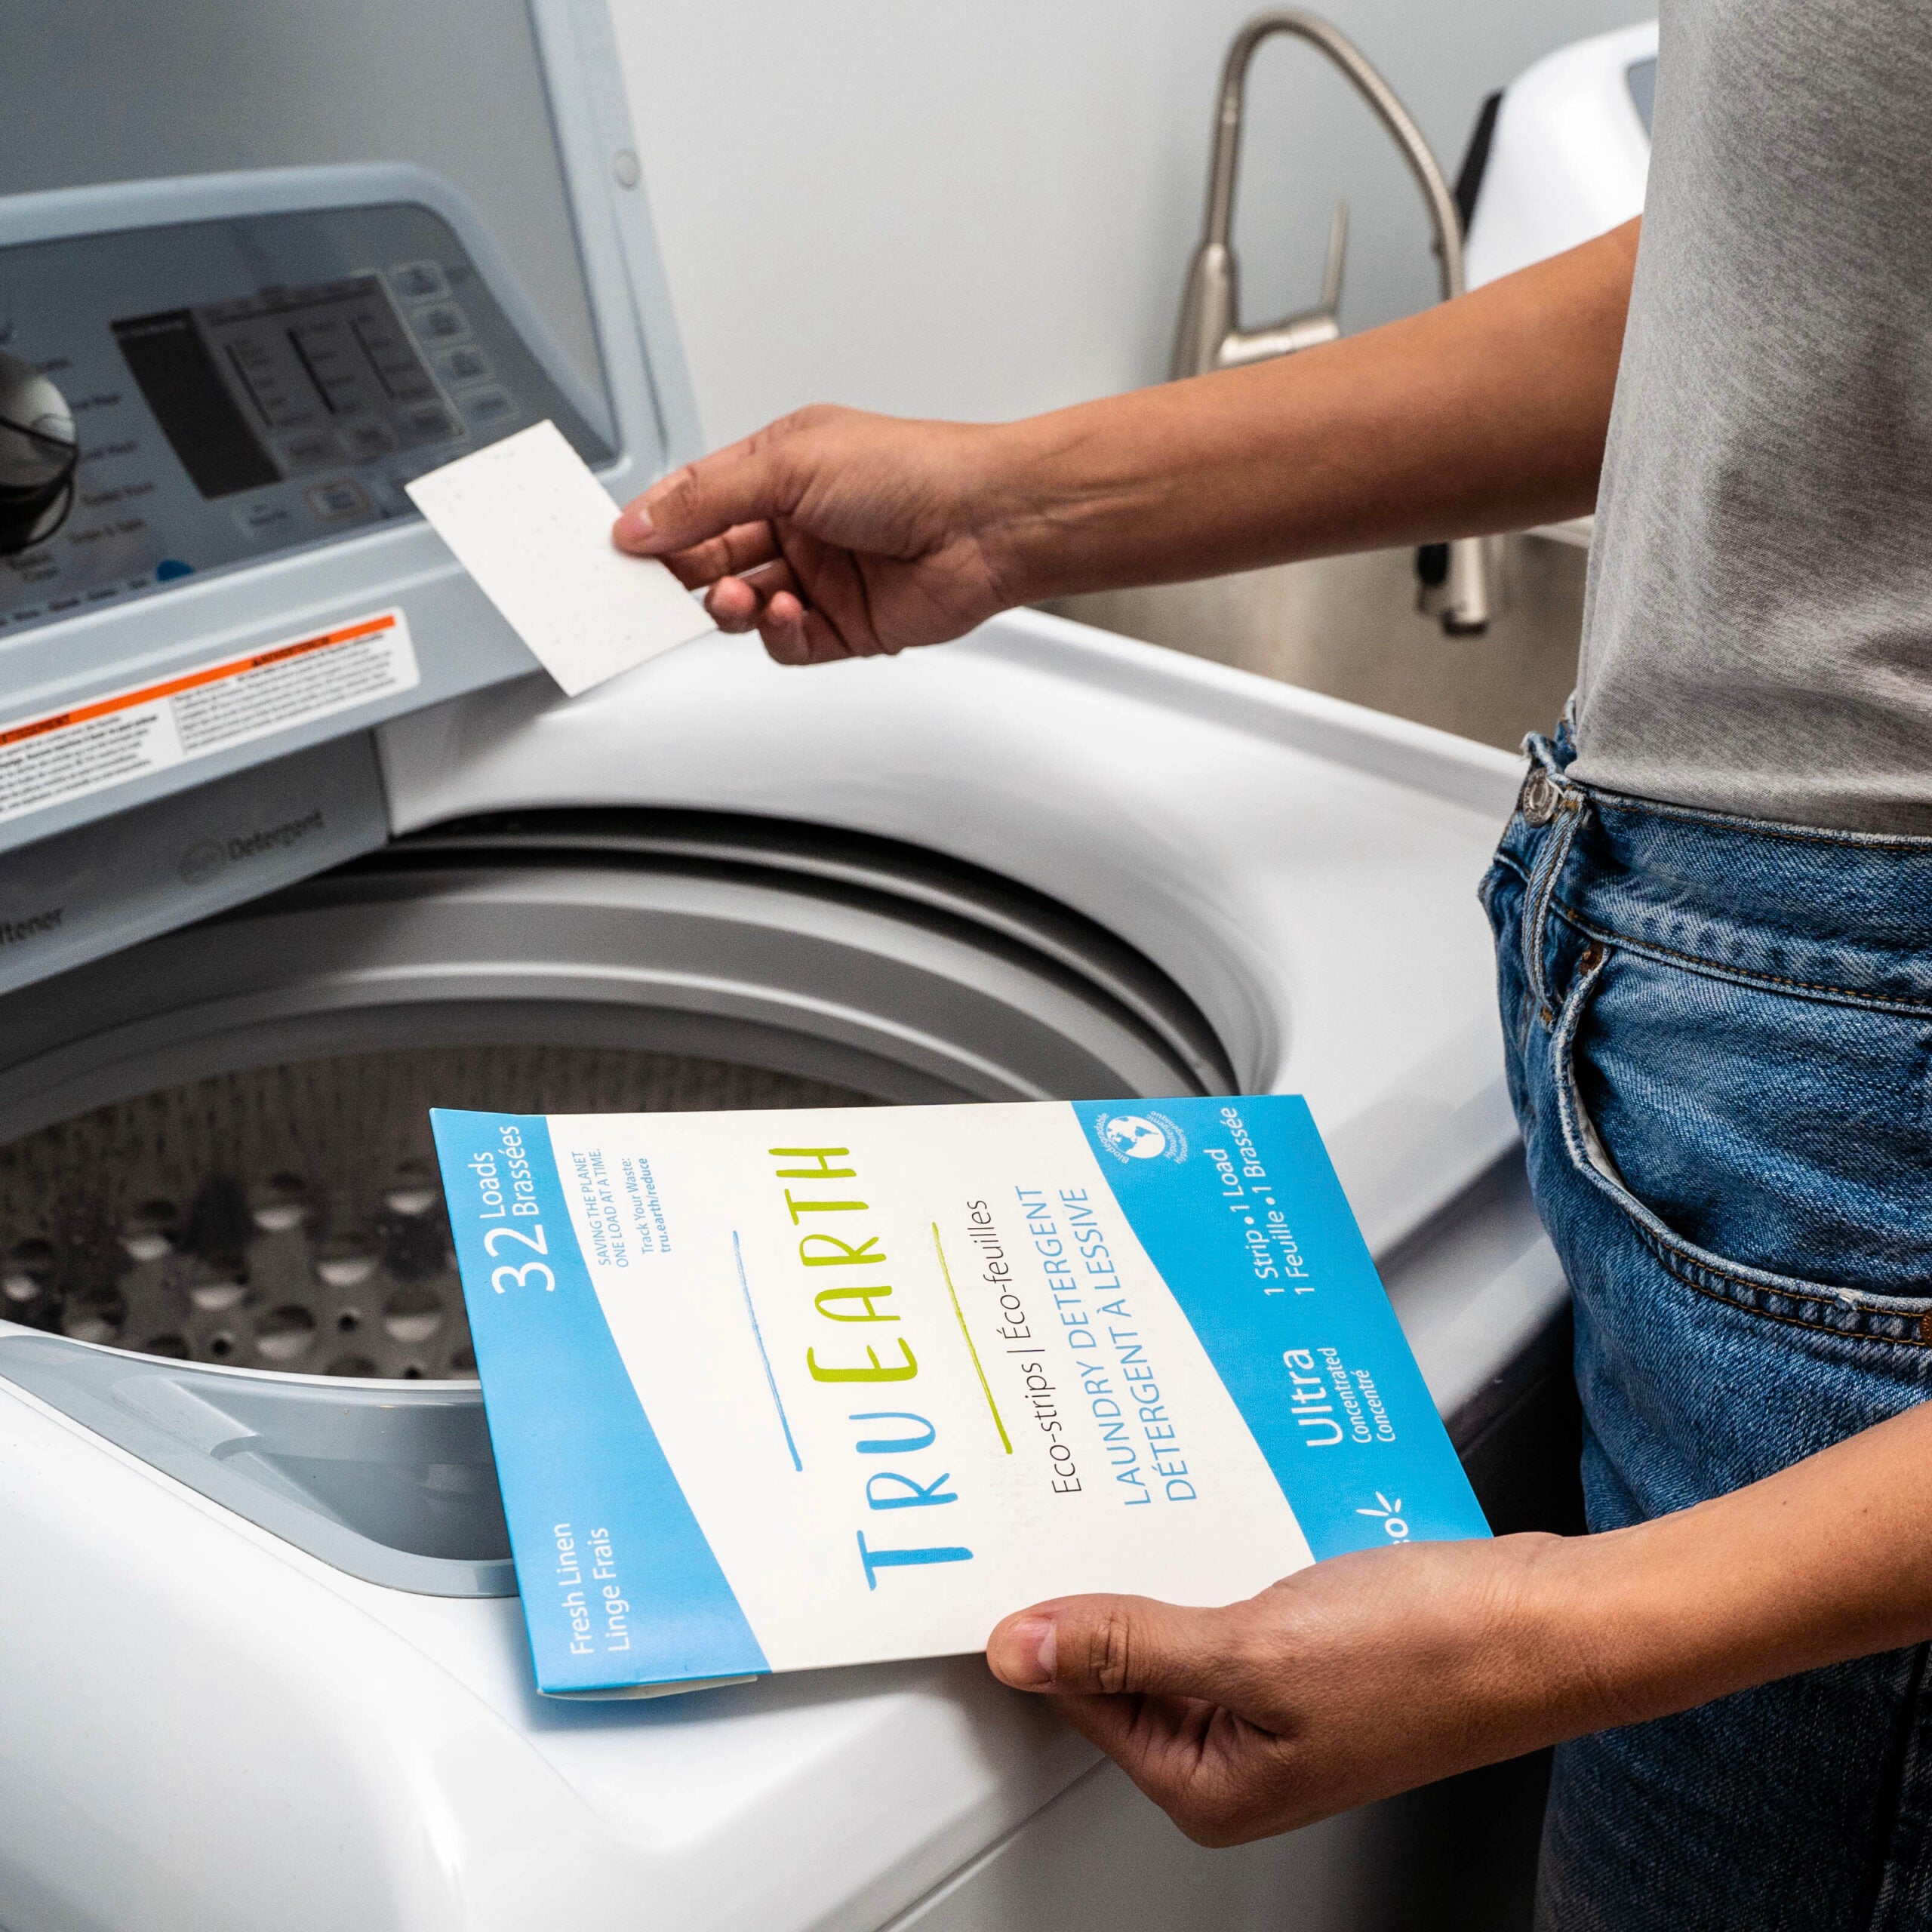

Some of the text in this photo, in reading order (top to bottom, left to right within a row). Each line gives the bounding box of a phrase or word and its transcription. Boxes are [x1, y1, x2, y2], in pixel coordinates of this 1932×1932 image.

[228, 811, 325, 860] Detergent
[468, 1152, 506, 1219] Loads
[498, 1125, 540, 1217] Brassées
[1204, 1149, 1244, 1196] Load
[1220, 1107, 1266, 1178] Brassée
[571, 1152, 611, 1265] SAVING THE PLANET
[589, 1148, 629, 1268] ONE LOAD AT A TIME.
[622, 1158, 654, 1255] Track Your Waste:
[638, 1158, 672, 1254] tru.earth/reduce
[1245, 1230, 1278, 1278] Strip
[1266, 1211, 1309, 1278] Feuille
[484, 1225, 555, 1294] 32
[967, 1200, 1031, 1339] Éco-feuilles
[768, 1147, 974, 1591] TRU EARTH
[1015, 1186, 1151, 1506] LAUNDRY DETERGENT
[1060, 1188, 1197, 1502] DÉTERGENT À LESSIVE
[1021, 1363, 1081, 1493] Eco-strips
[1283, 1349, 1343, 1447] Ultra
[1317, 1346, 1372, 1444] Concentrated
[1350, 1370, 1395, 1442] Concentré
[554, 1523, 595, 1654] Fresh Linen
[587, 1527, 630, 1651] Linge Frais
